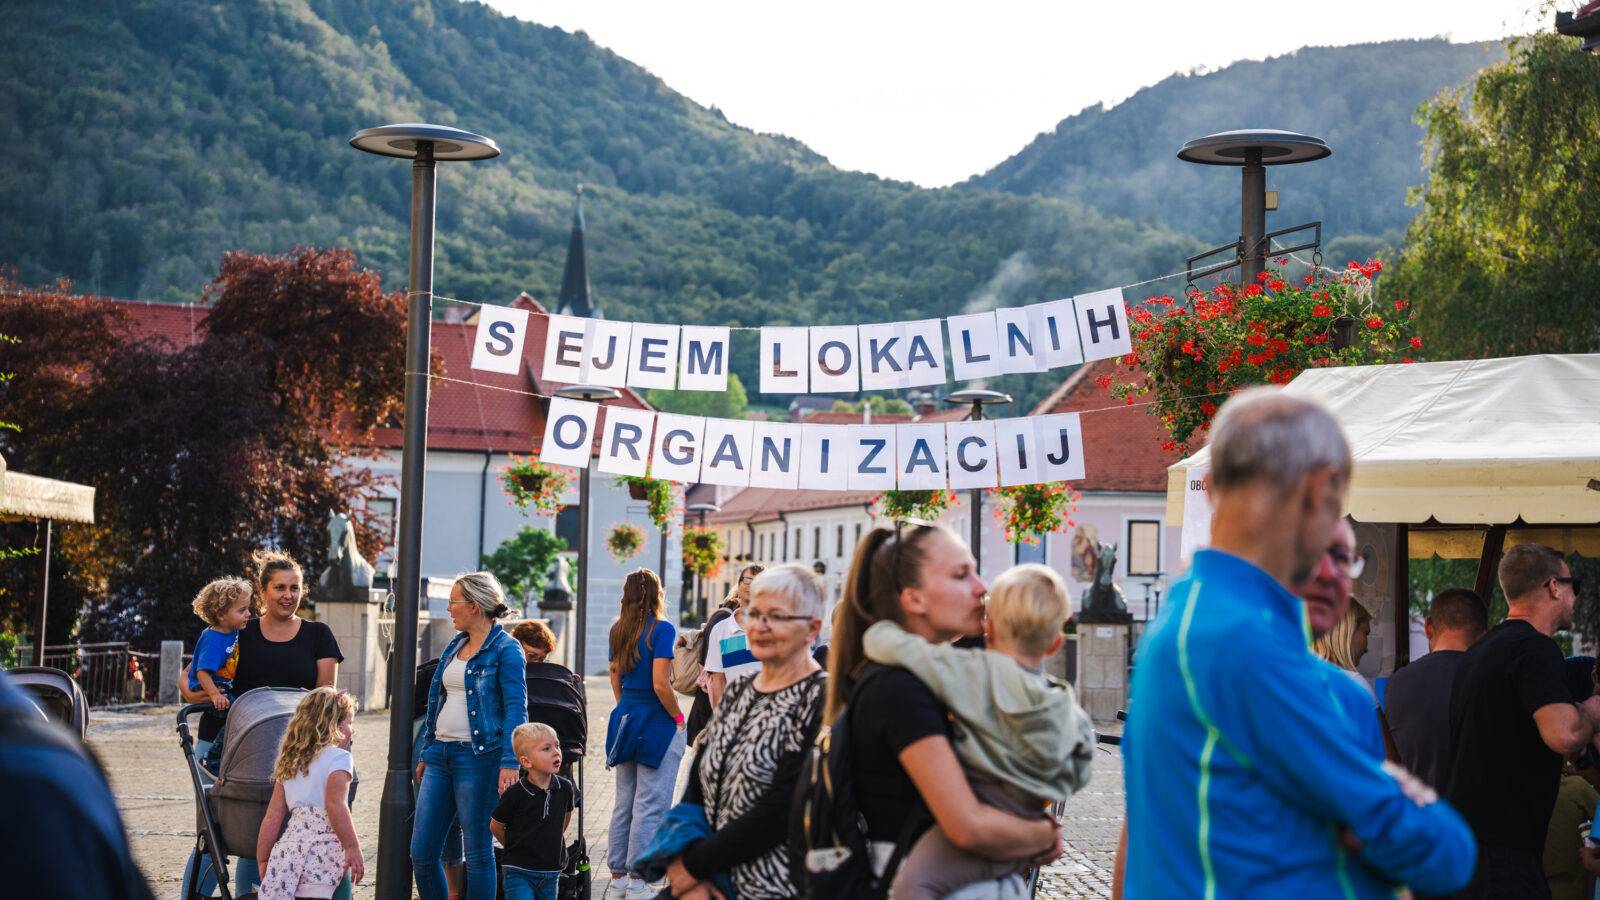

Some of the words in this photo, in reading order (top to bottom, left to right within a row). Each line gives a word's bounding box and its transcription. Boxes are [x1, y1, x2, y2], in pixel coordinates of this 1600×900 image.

[485, 320, 723, 375] SEJEM
[773, 304, 1120, 378] LOKALNIH
[552, 414, 1070, 474] ORGANIZACIJ
